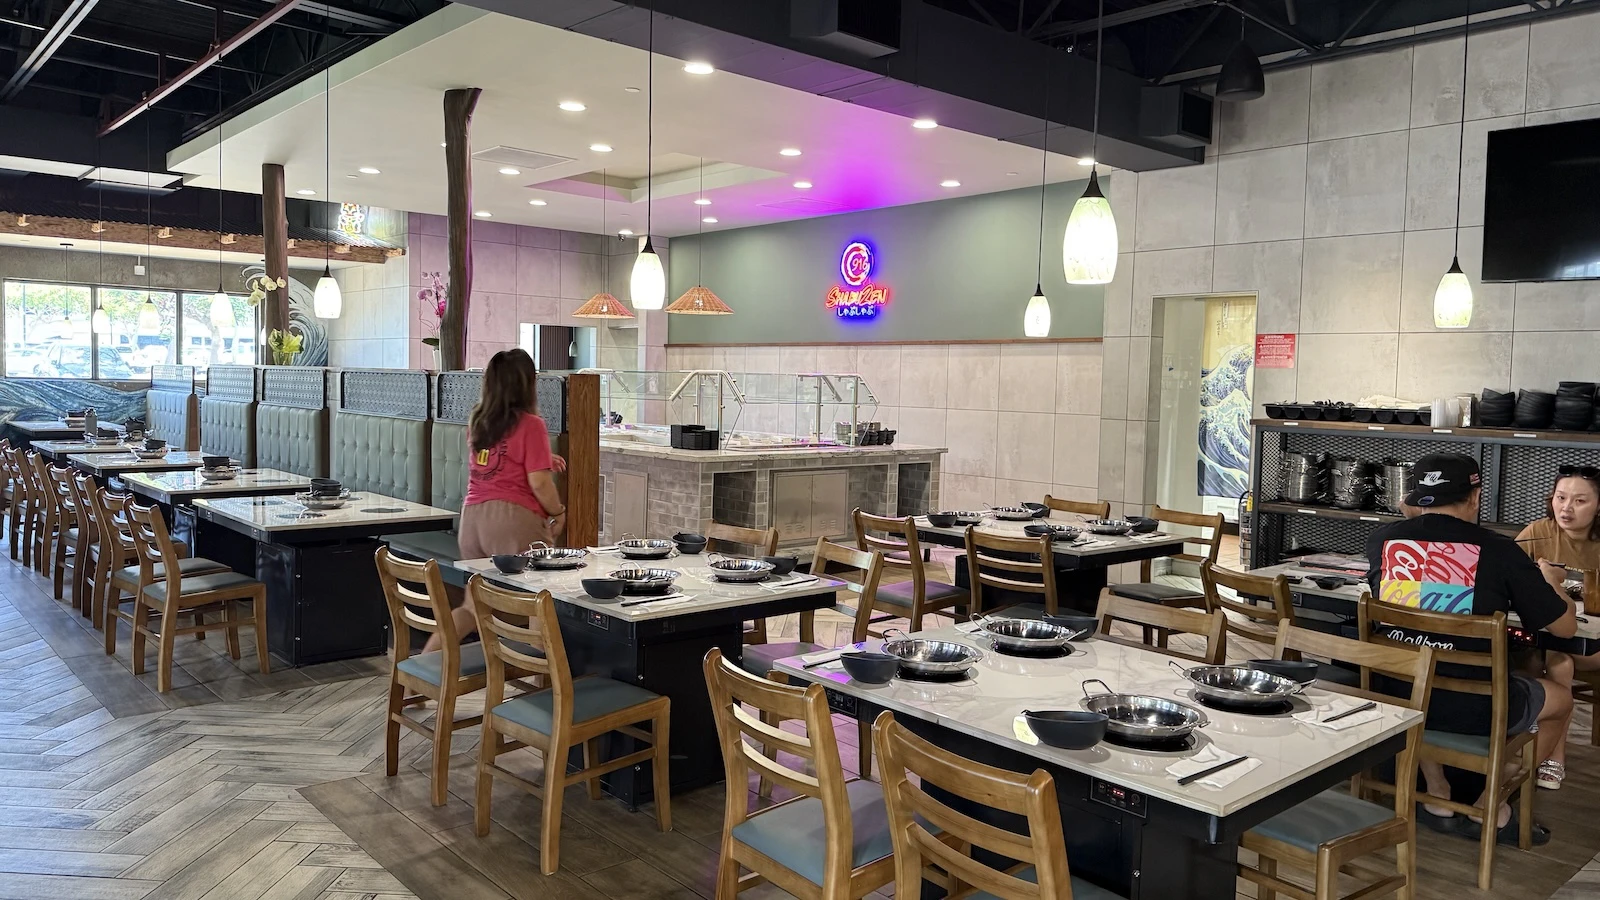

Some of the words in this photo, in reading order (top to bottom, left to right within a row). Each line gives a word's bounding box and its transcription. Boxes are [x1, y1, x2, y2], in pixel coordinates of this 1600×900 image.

[837, 306, 874, 317] しゃぶしゃぶ
